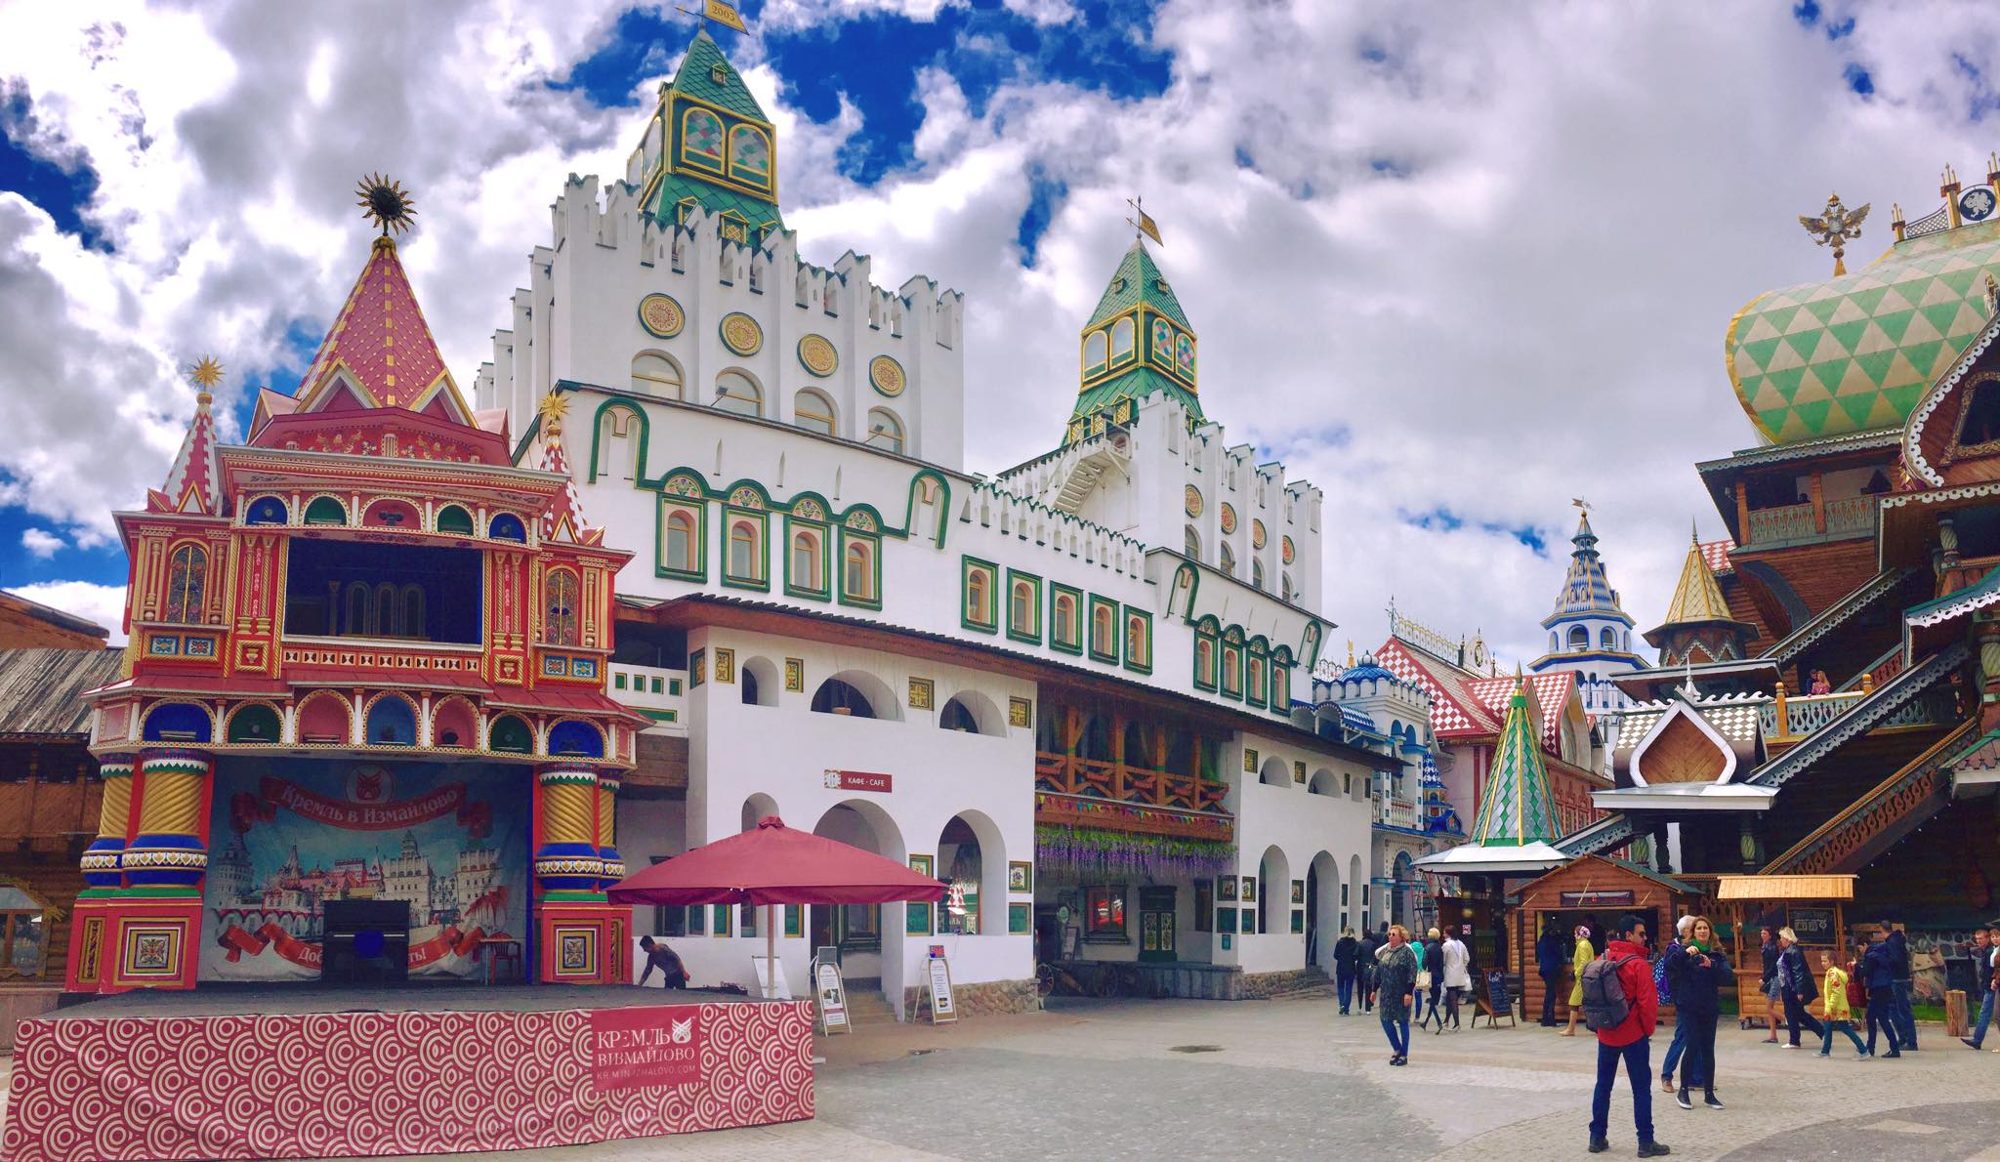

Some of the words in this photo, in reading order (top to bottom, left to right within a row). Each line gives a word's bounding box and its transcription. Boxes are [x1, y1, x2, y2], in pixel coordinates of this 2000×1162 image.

[848, 777, 864, 785] КАФЕ
[282, 785, 343, 822] Кремль
[348, 811, 358, 823] в
[364, 790, 457, 824] Измайлово
[597, 1028, 670, 1048] КРЕМЛЬ
